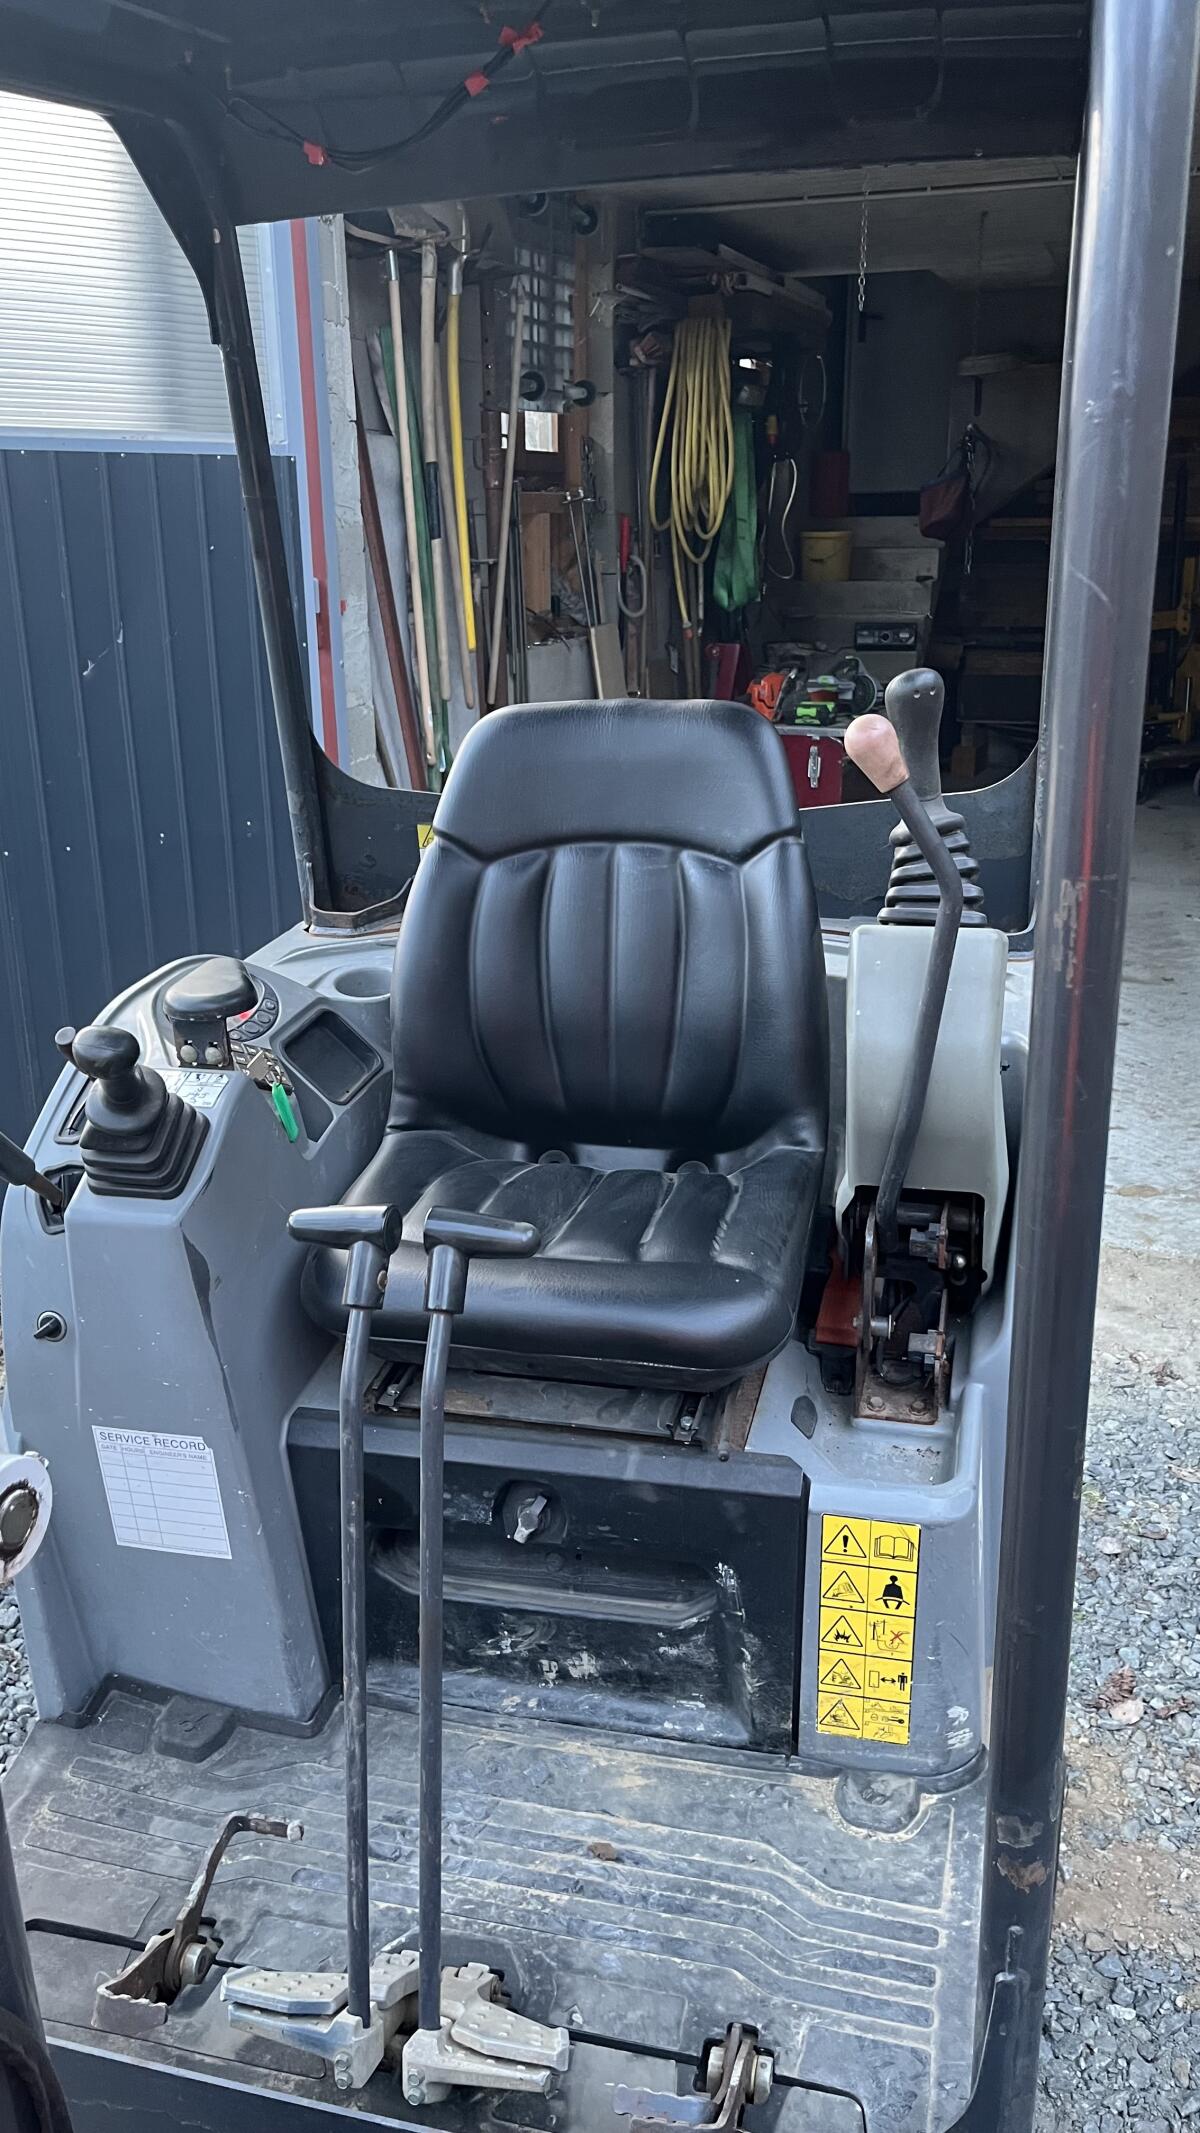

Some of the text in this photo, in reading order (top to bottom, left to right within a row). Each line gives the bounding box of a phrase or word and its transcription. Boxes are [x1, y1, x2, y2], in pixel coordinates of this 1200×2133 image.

[99, 1431, 206, 1452] SERVICE RECORD
[100, 1443, 118, 1451] DATE
[188, 1453, 208, 1461] NAME
